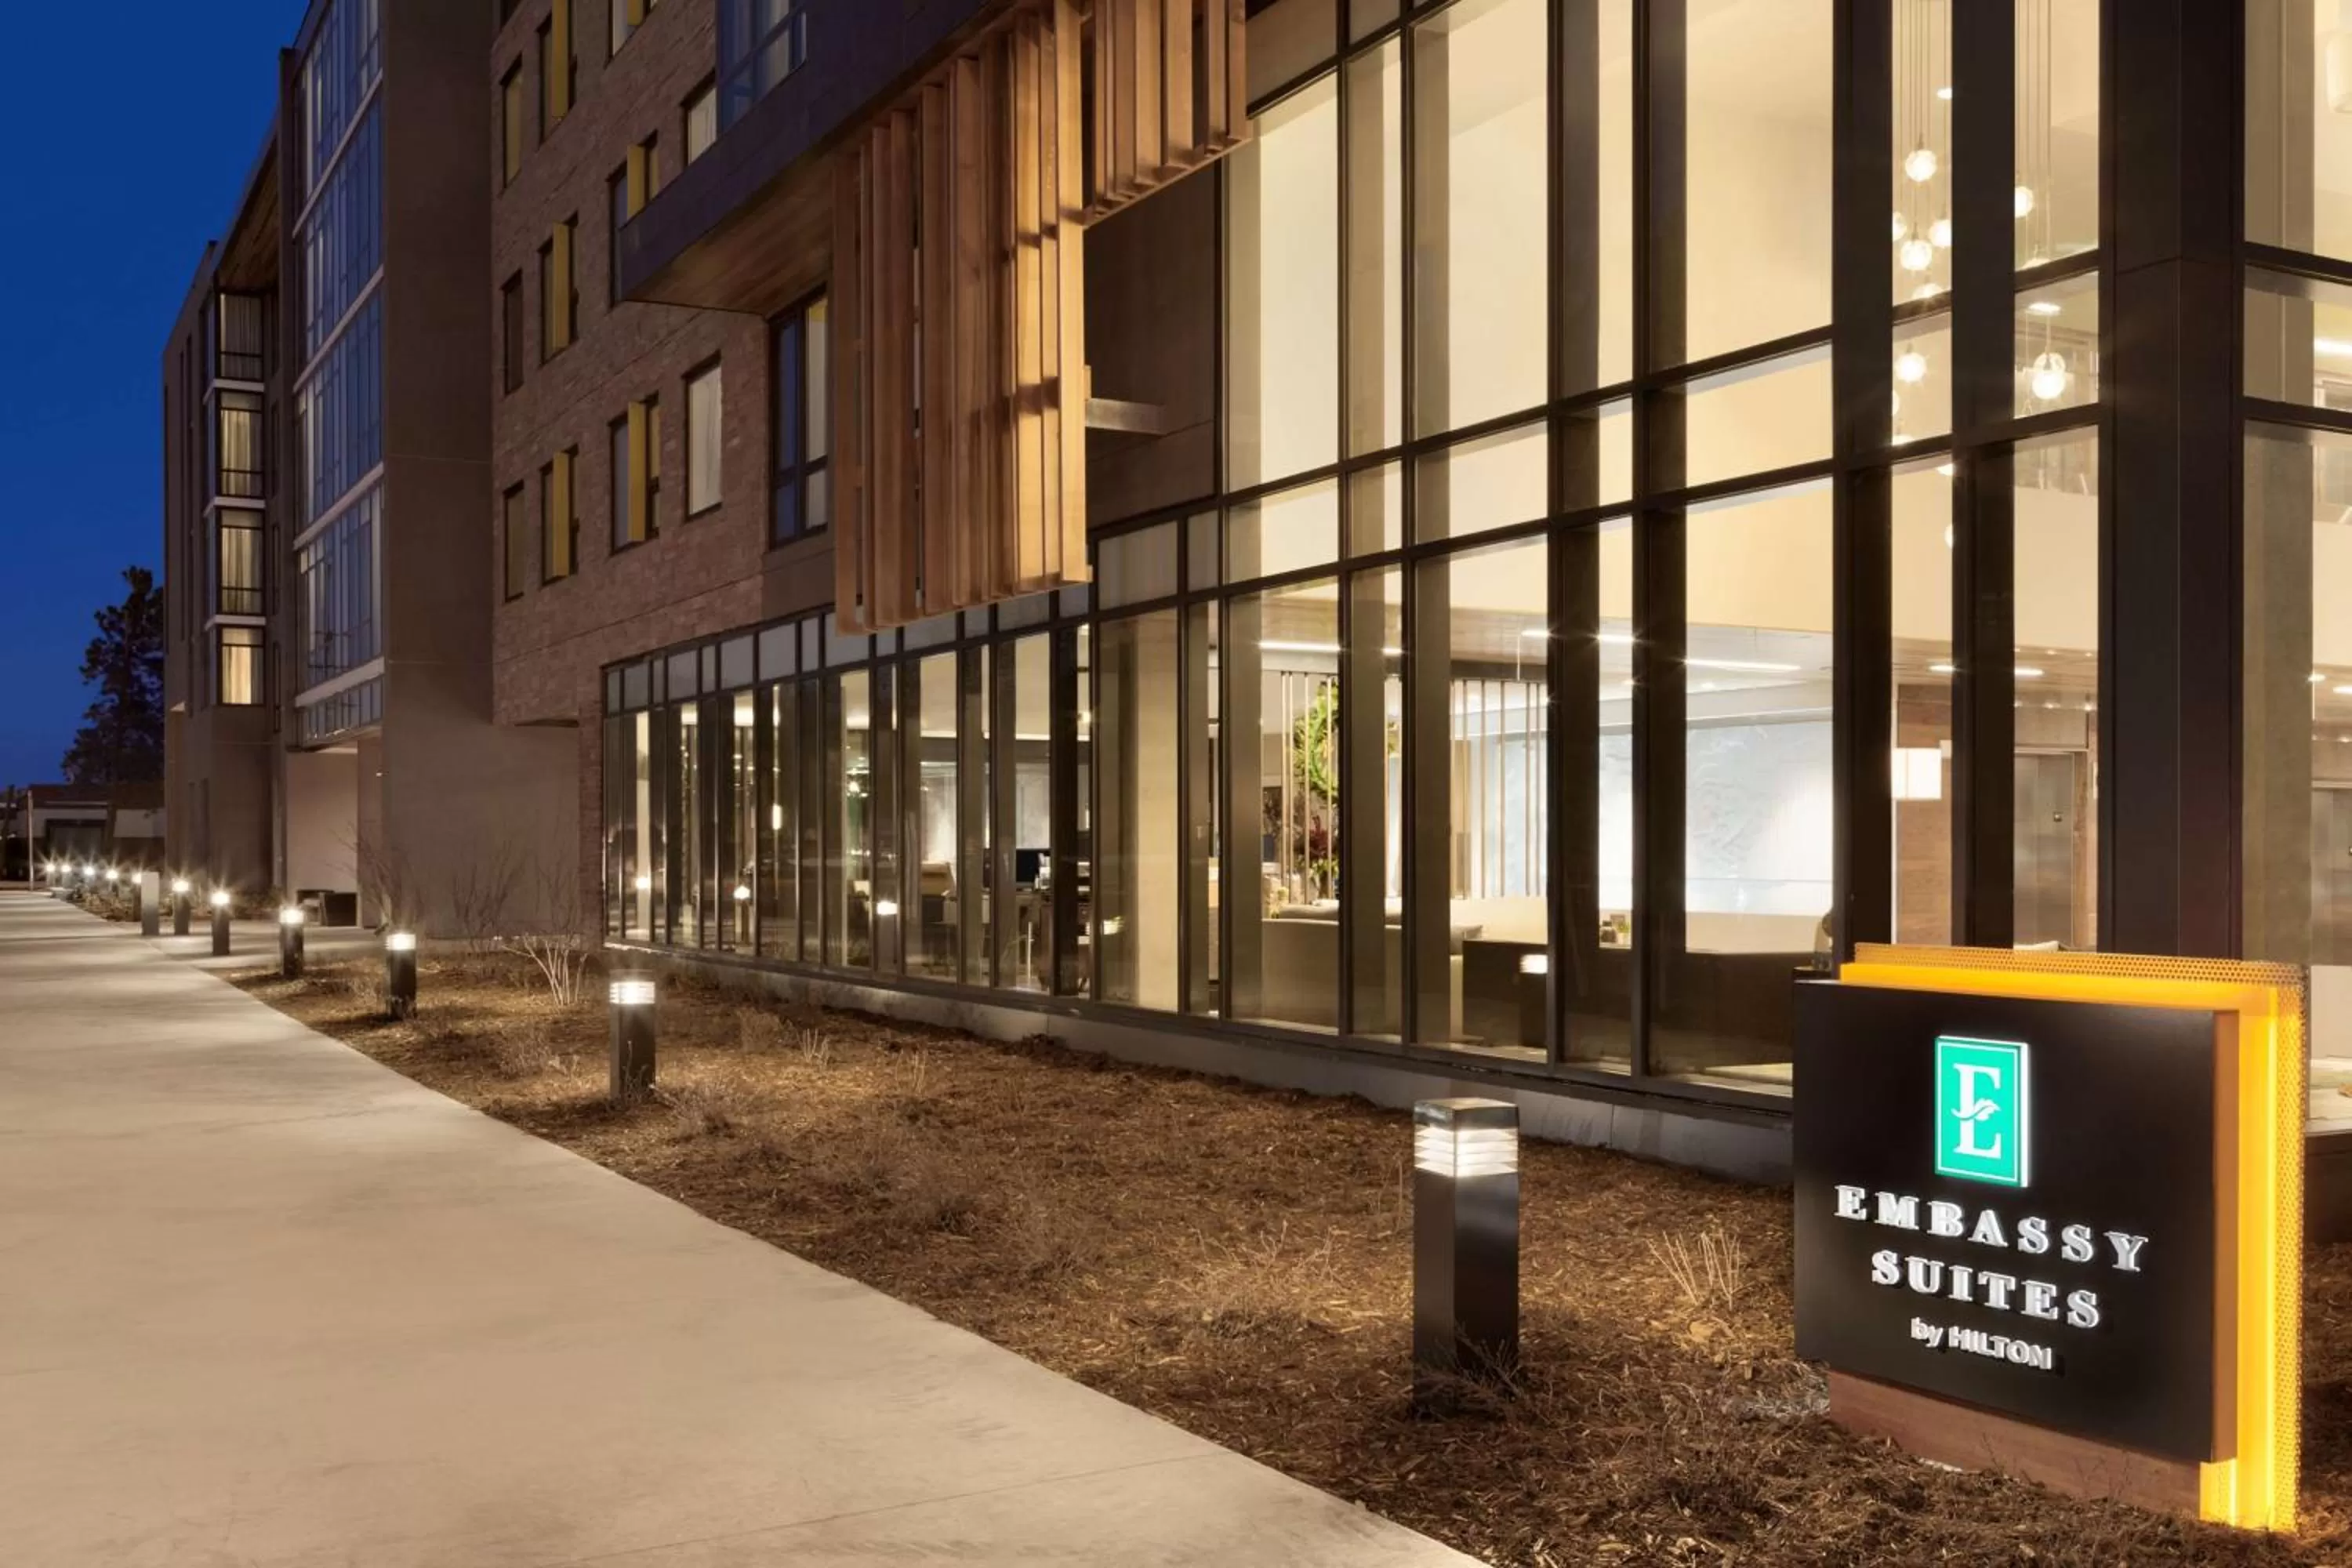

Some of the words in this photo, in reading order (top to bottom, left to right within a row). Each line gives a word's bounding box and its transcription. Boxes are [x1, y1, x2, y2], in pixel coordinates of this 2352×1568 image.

[1950, 1062, 2002, 1160] E
[1833, 1185, 2149, 1272] EMBASSY
[1871, 1250, 2100, 1328] SUITES
[1911, 1317, 1943, 1348] by
[1948, 1327, 2053, 1370] HILTON
